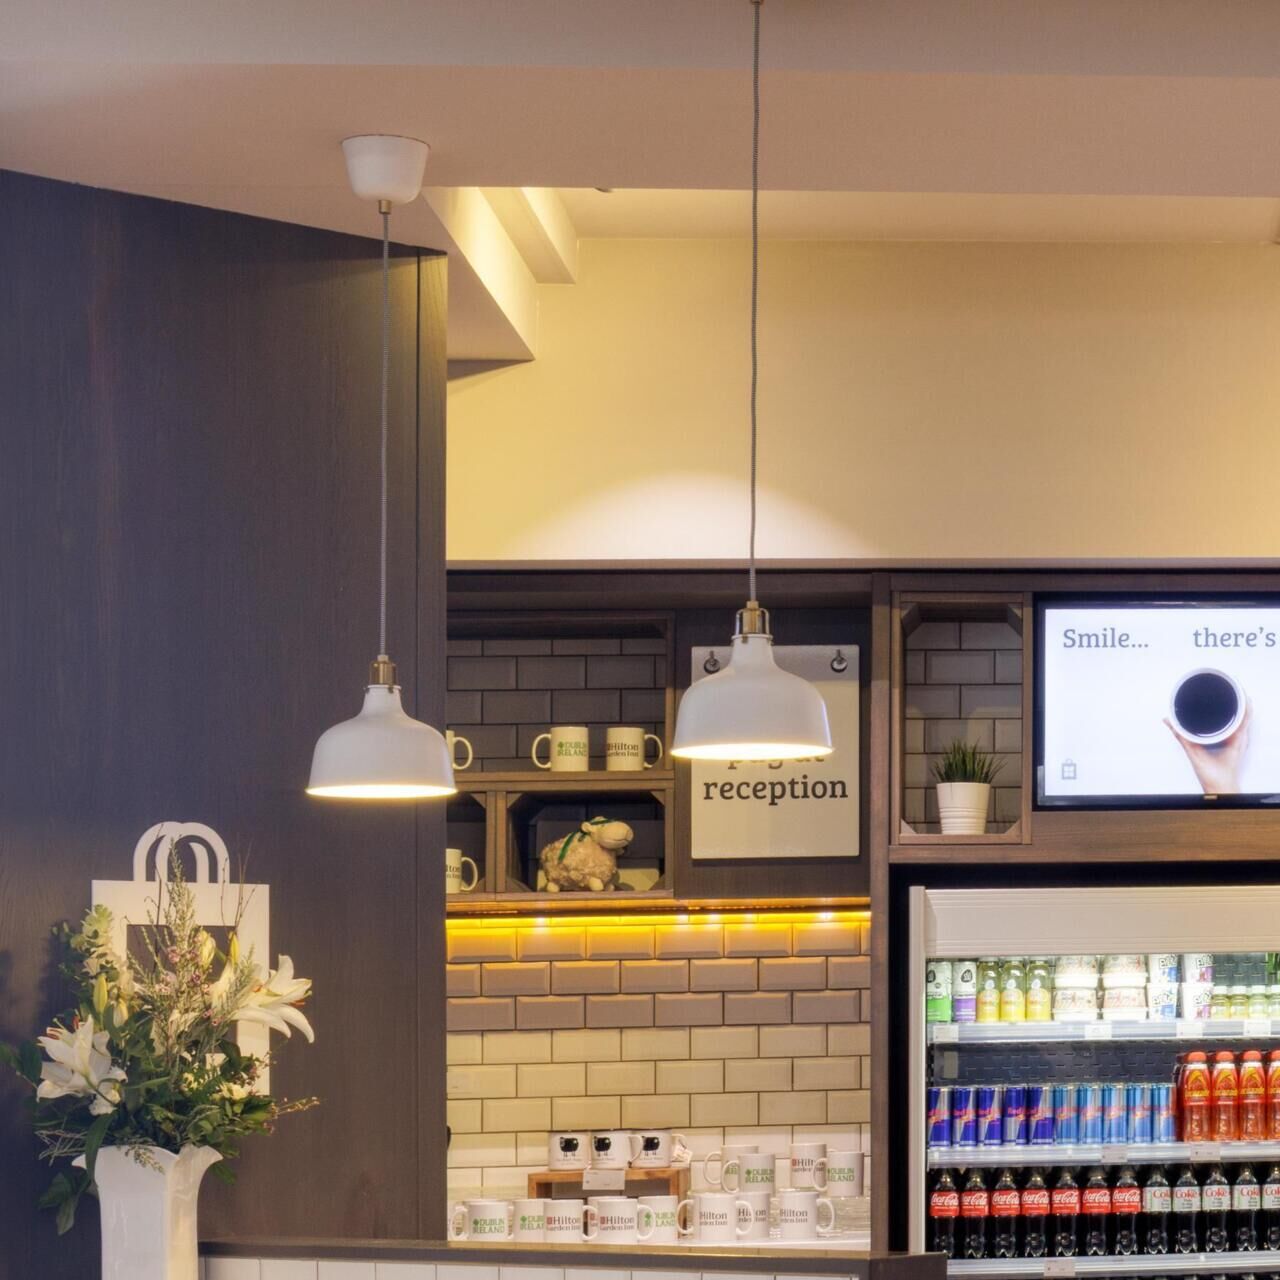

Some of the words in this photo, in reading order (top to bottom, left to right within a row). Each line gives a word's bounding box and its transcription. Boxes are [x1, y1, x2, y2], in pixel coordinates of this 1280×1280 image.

[1062, 628, 1149, 649] Smile...
[1193, 627, 1276, 648] there’s
[703, 774, 849, 806] reception
[605, 1215, 635, 1225] Hilton
